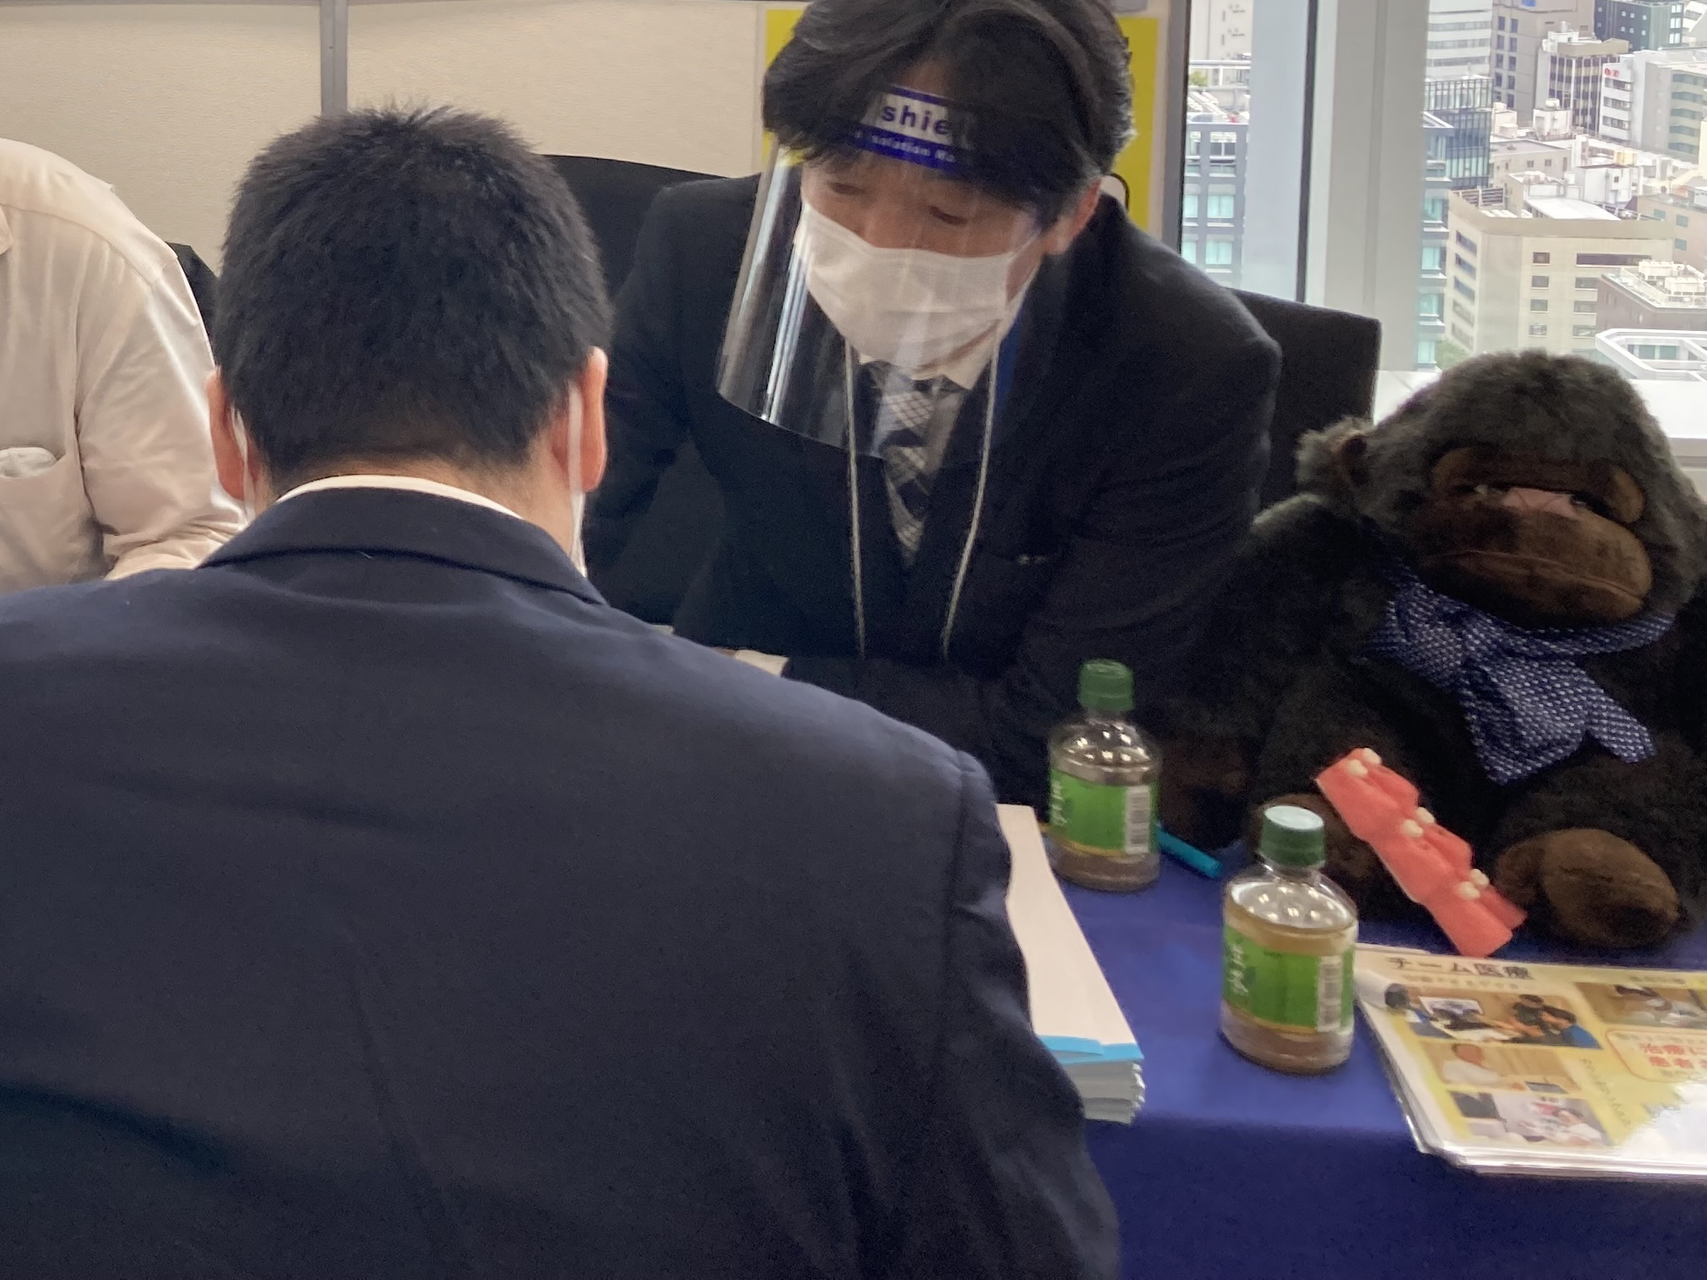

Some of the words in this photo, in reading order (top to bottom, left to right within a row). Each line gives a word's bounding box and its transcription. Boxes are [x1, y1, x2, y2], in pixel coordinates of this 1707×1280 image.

[1386, 956, 1535, 982] チーム医療
